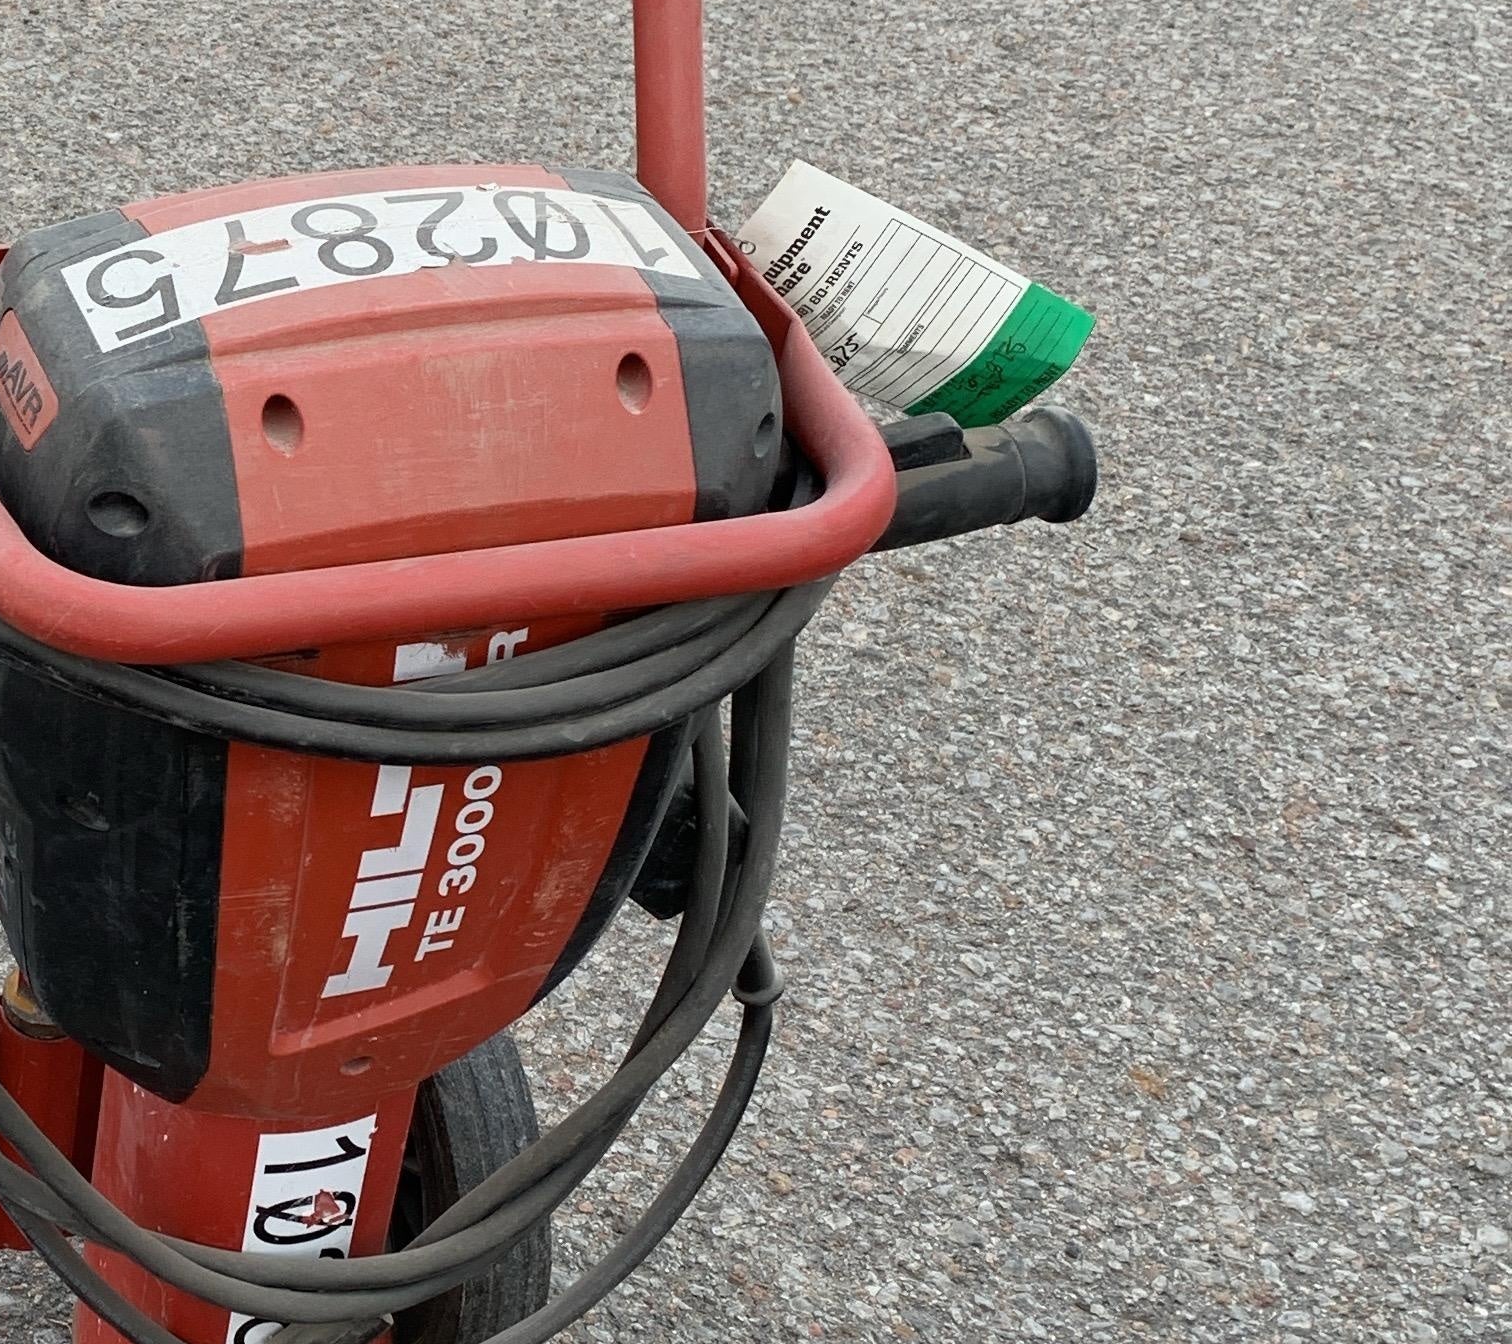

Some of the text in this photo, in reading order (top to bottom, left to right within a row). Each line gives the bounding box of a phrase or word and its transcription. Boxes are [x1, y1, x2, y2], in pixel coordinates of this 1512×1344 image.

[763, 206, 831, 286] uipment
[809, 241, 863, 305] 80-RENTS
[775, 262, 812, 297] hare
[831, 333, 859, 373] 875
[1, 359, 43, 429] AVR
[414, 905, 466, 962] TE
